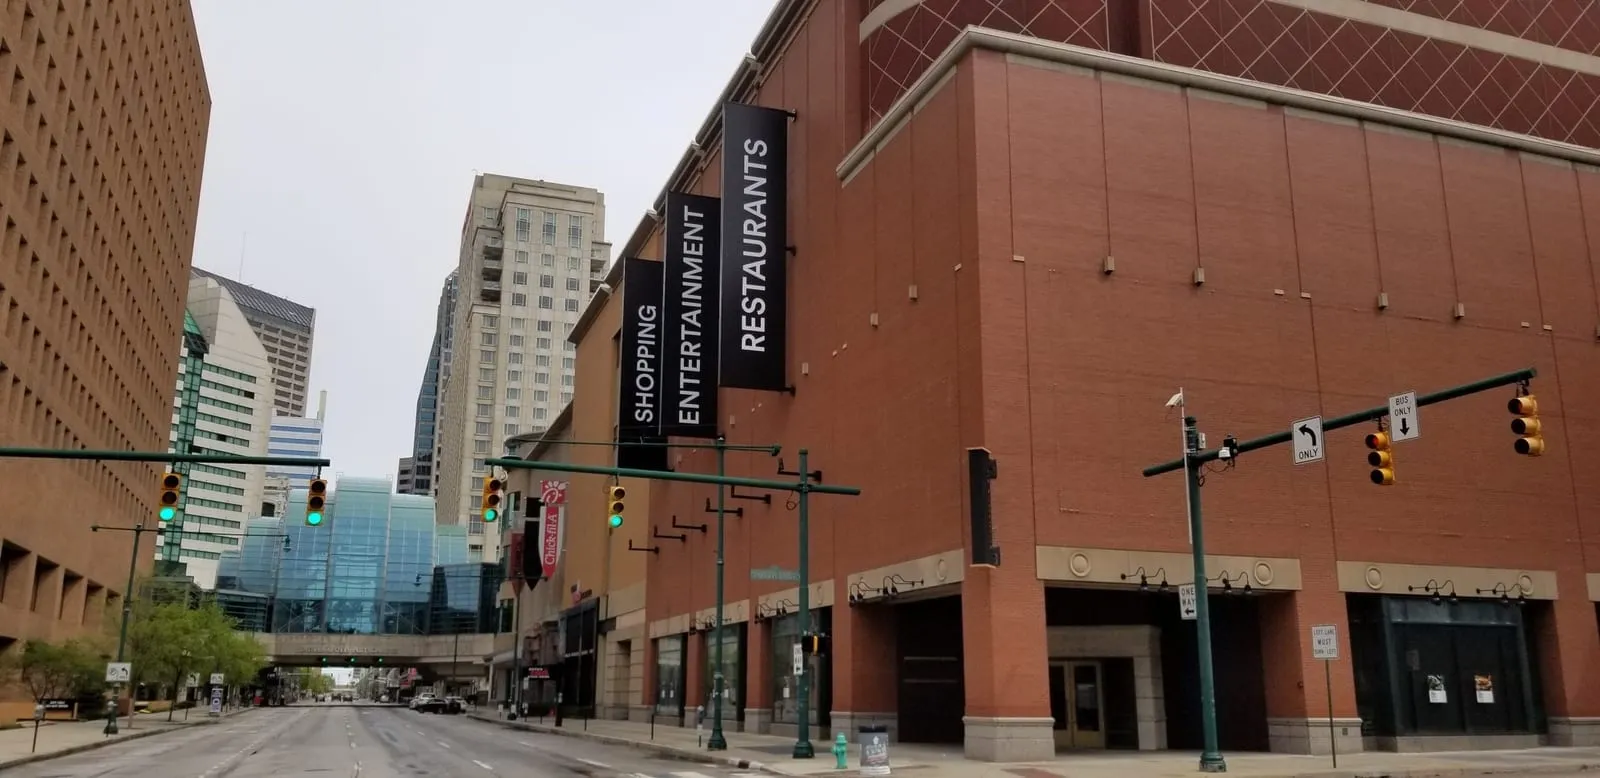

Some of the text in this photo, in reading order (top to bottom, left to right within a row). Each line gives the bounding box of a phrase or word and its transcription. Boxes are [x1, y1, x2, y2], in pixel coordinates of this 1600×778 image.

[741, 138, 768, 352] RESTAURANTS
[678, 205, 704, 425] ENTERTAINMENT
[635, 304, 657, 423] SHOPPING
[1395, 396, 1409, 406] BUS
[1394, 406, 1412, 416] ONLY
[1298, 448, 1319, 460] ONLY
[545, 513, 557, 565] Chick-fil-A
[1181, 587, 1195, 596] ONE
[1182, 598, 1195, 607] WAY
[1317, 638, 1332, 646] MUST
